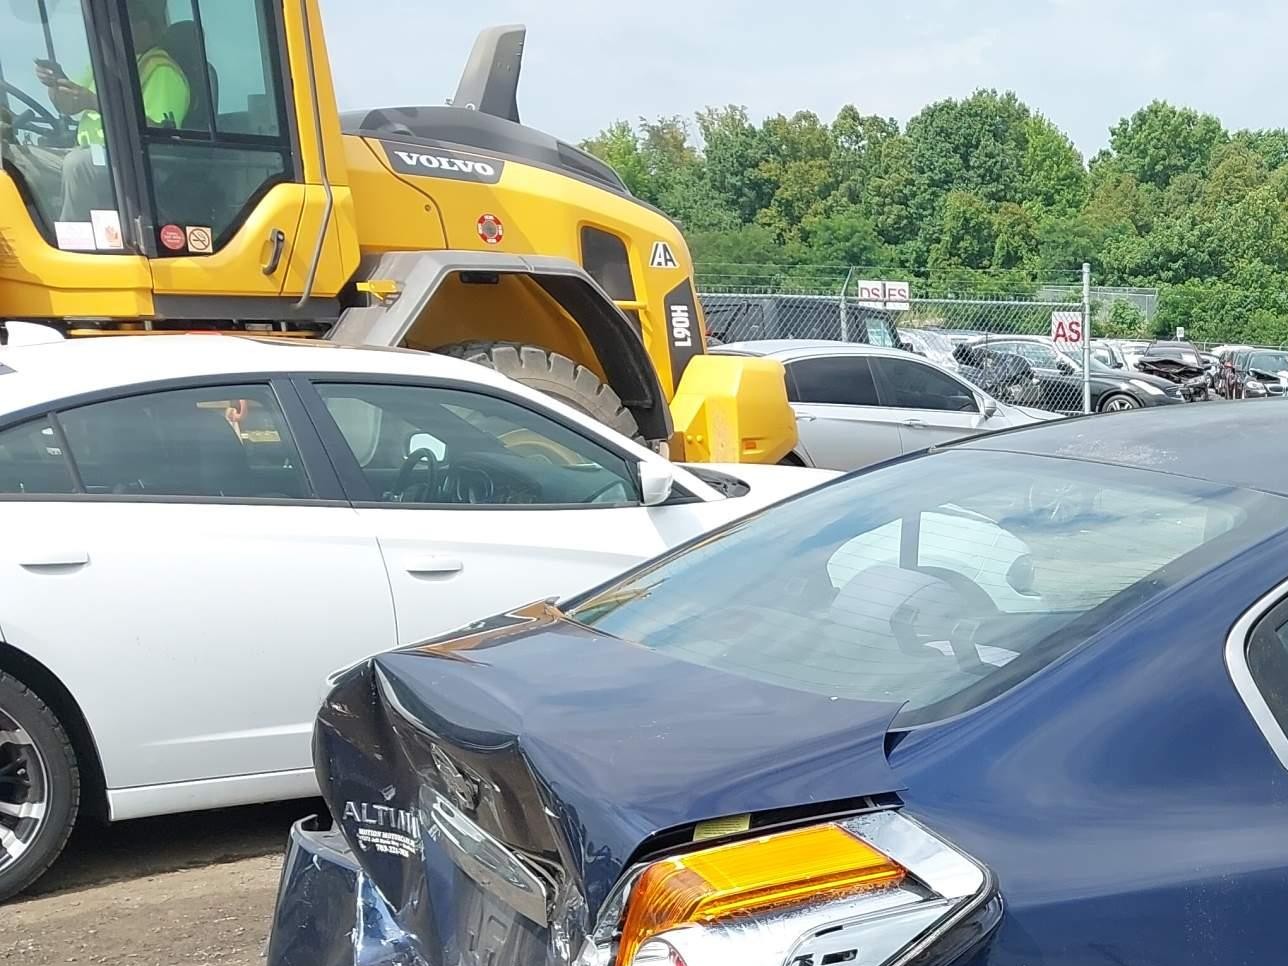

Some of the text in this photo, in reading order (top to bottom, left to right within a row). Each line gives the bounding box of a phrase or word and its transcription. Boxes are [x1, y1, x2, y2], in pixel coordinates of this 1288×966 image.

[394, 151, 495, 175] VOLVO
[670, 304, 692, 347] L90H
[1053, 321, 1080, 342] AS
